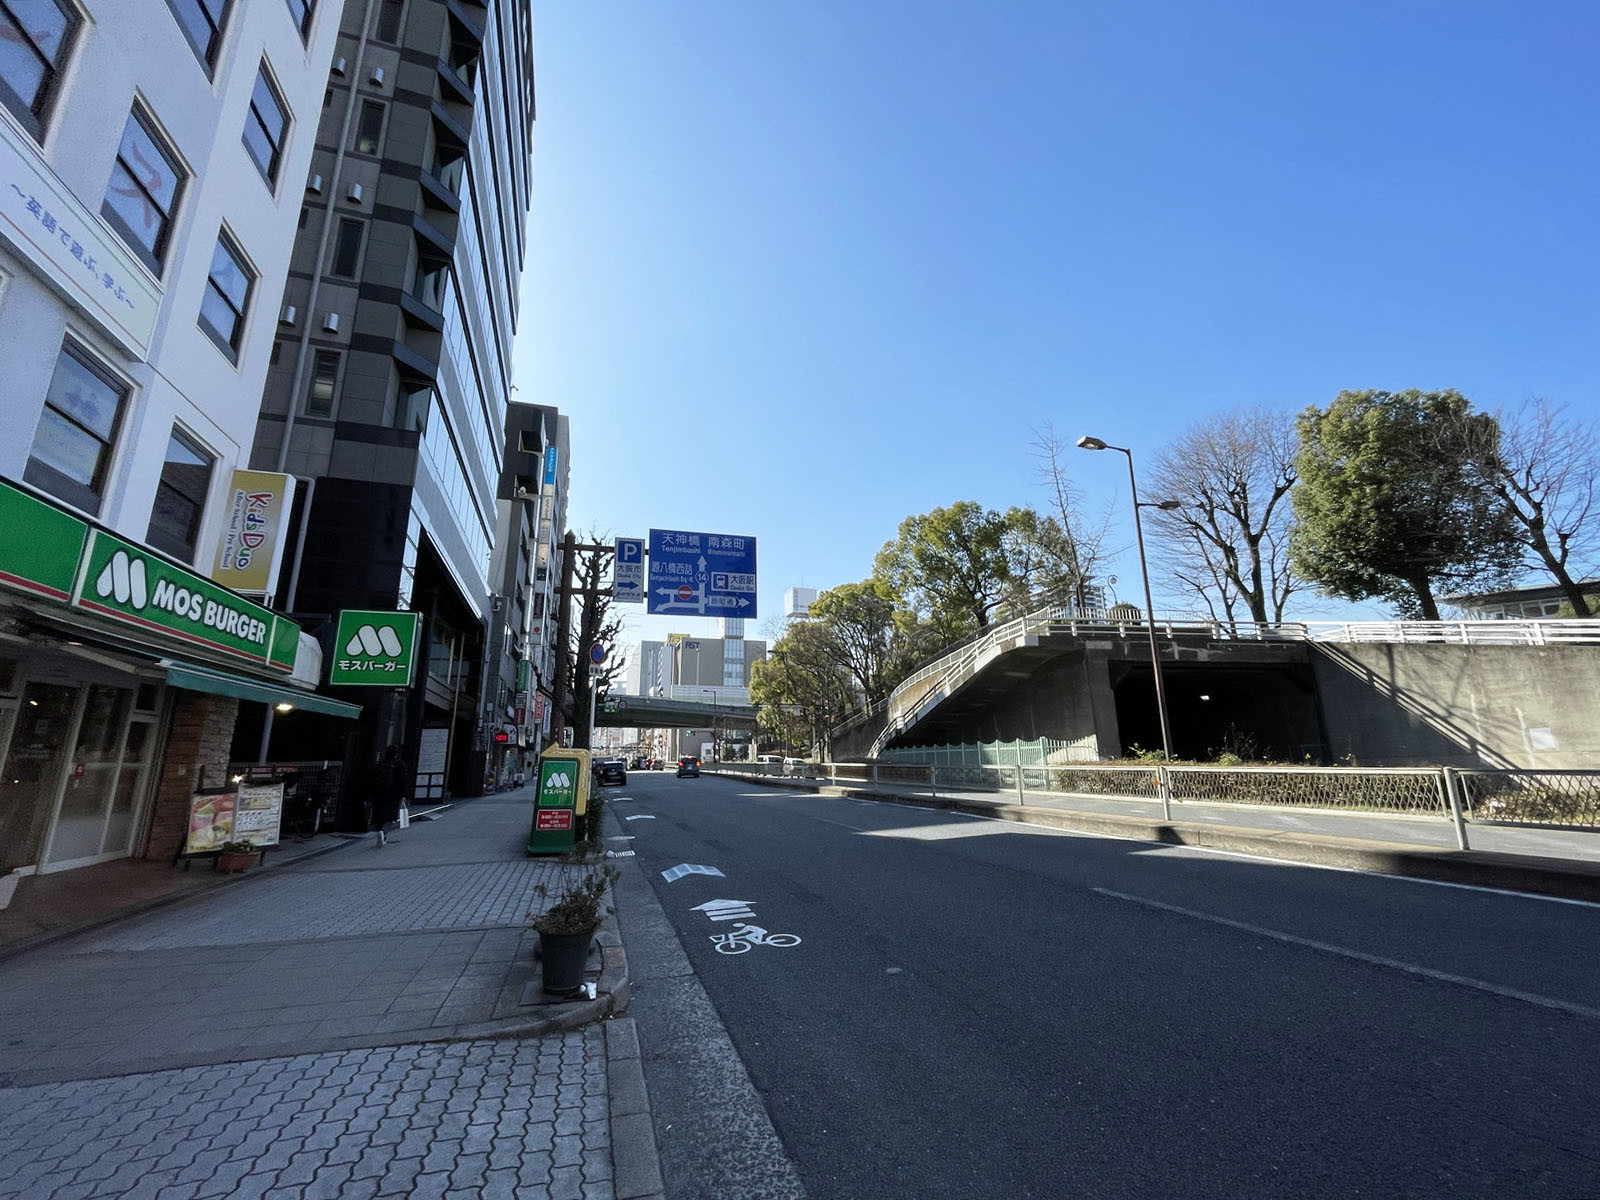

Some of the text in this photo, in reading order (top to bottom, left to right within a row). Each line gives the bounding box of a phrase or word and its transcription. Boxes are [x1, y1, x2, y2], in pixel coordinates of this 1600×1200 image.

[662, 532, 745, 550] 天神橋 南森町
[623, 543, 638, 561] P
[152, 579, 267, 645] MOS BURGER
[338, 660, 406, 672] モスバーガー
